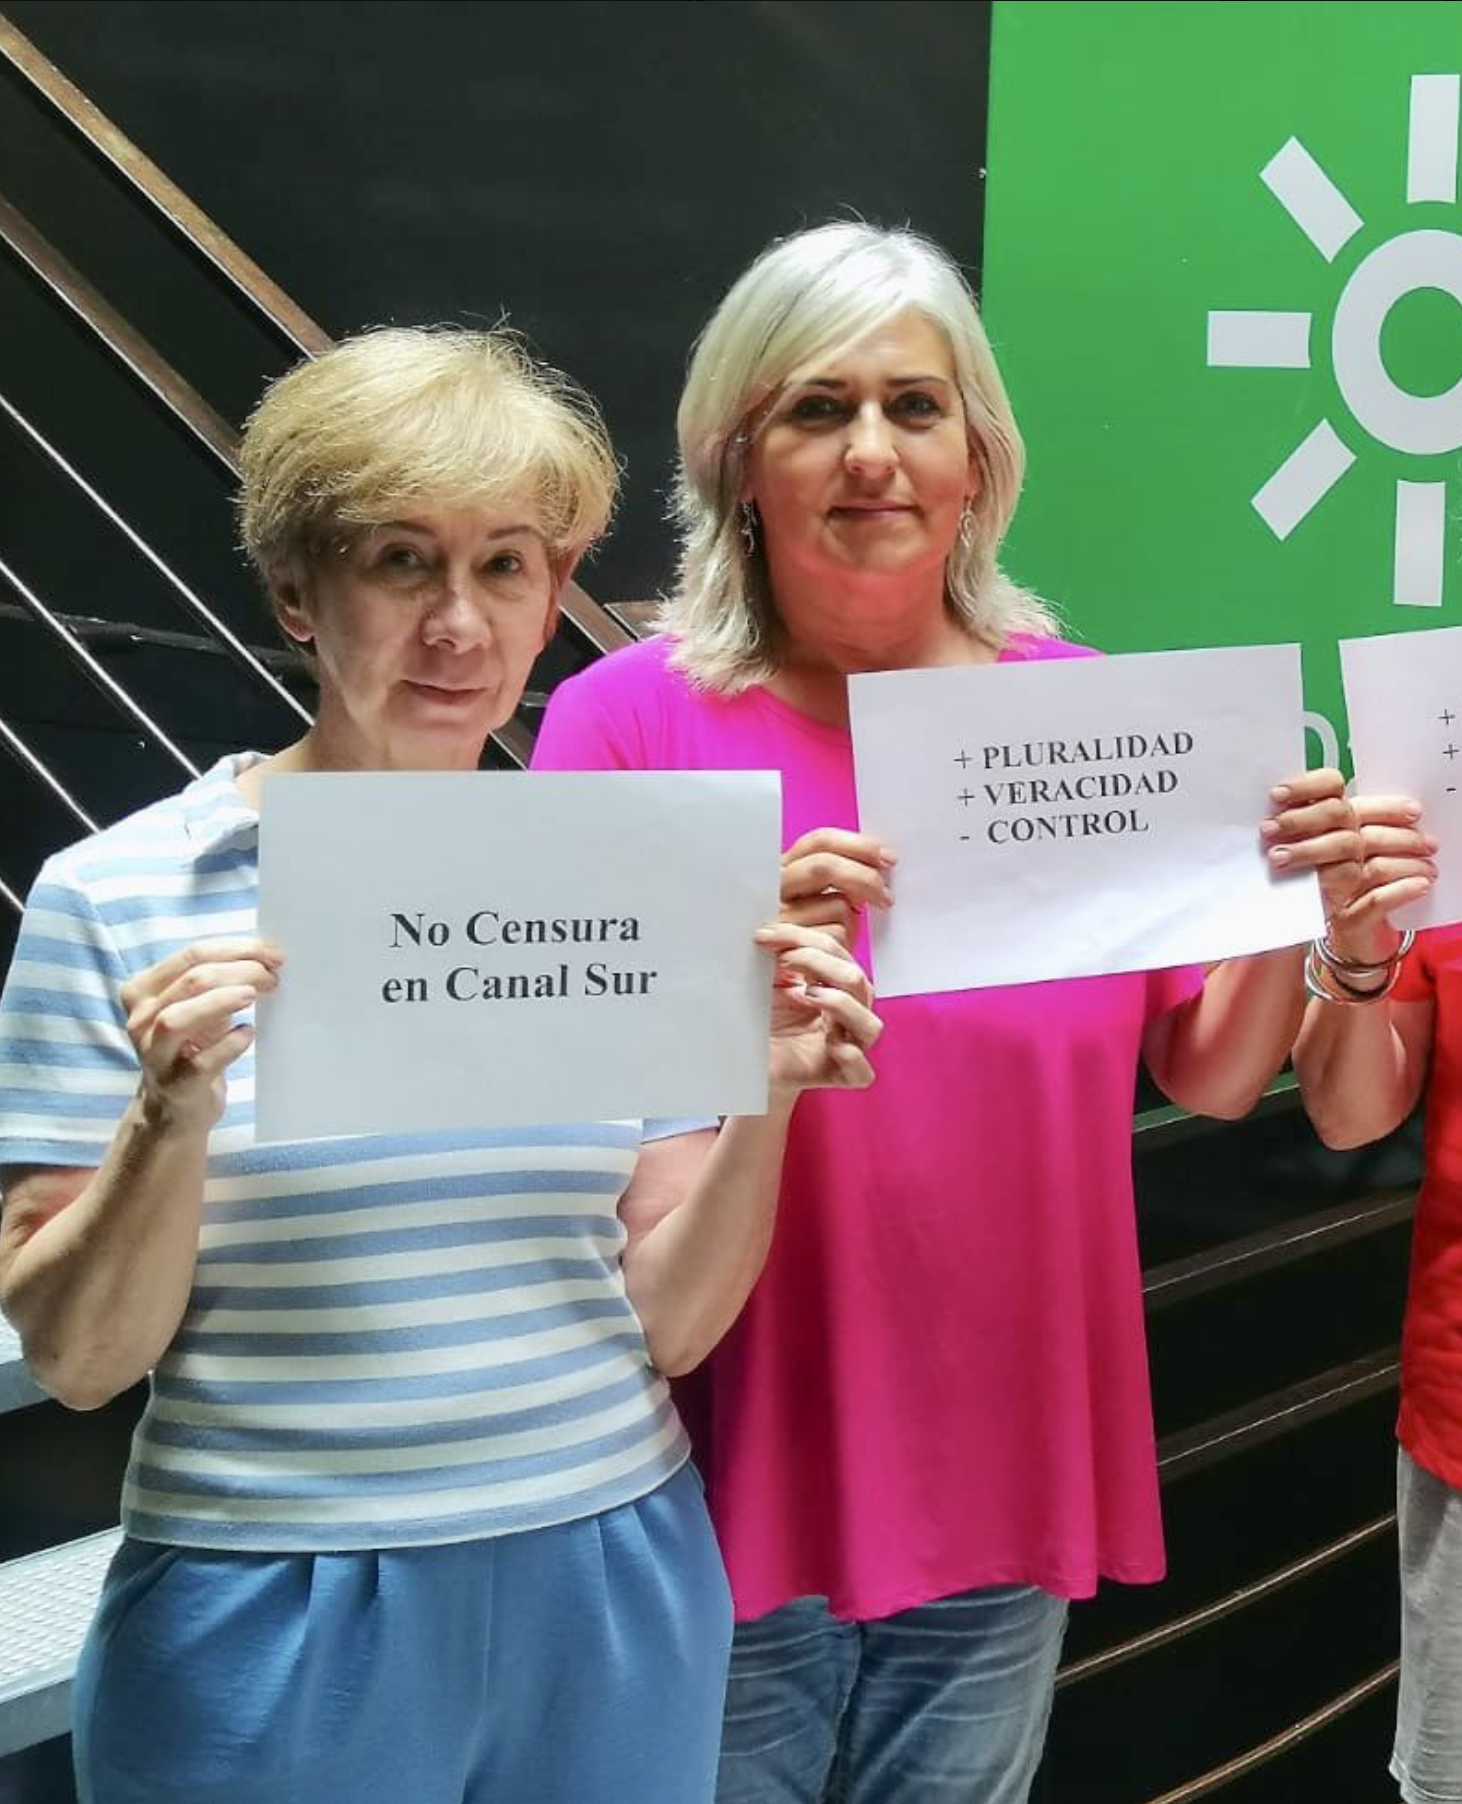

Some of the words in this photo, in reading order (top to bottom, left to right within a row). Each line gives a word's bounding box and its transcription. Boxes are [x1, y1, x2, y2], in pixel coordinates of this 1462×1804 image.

[983, 731, 1193, 769] PLURALIDAD
[984, 770, 1178, 805] VERACIDAD
[987, 809, 1149, 844] CONTROL
[389, 912, 450, 948] No
[466, 910, 641, 946] Censura
[382, 977, 428, 1003] en
[446, 964, 569, 1001] Canal
[585, 963, 658, 996] Sur
